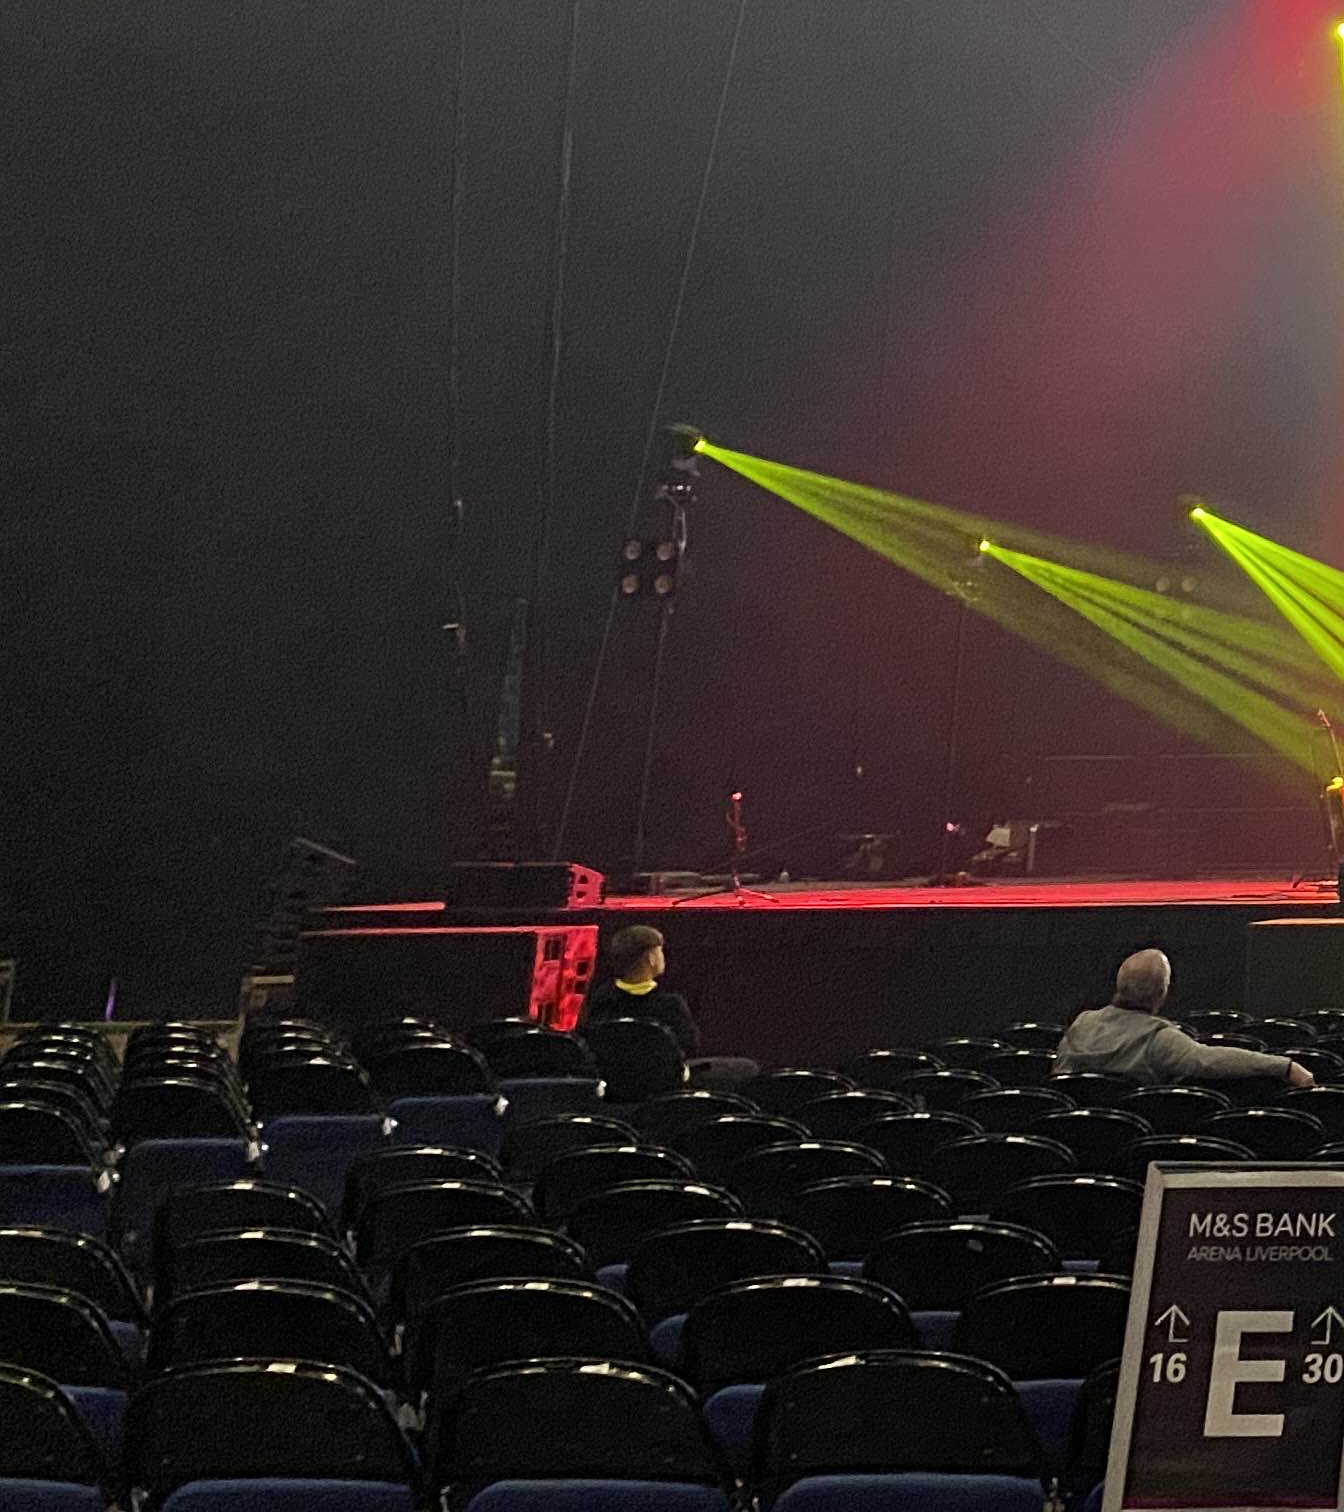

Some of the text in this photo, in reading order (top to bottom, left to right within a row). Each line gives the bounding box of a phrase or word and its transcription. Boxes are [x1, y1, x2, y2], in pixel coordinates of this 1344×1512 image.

[1188, 1212, 1336, 1238] M&S BANK
[1187, 1246, 1334, 1261] ARENA LIVERPOOL
[1149, 1353, 1187, 1383] 16
[1203, 1311, 1294, 1437] E
[1302, 1353, 1344, 1384] 30
